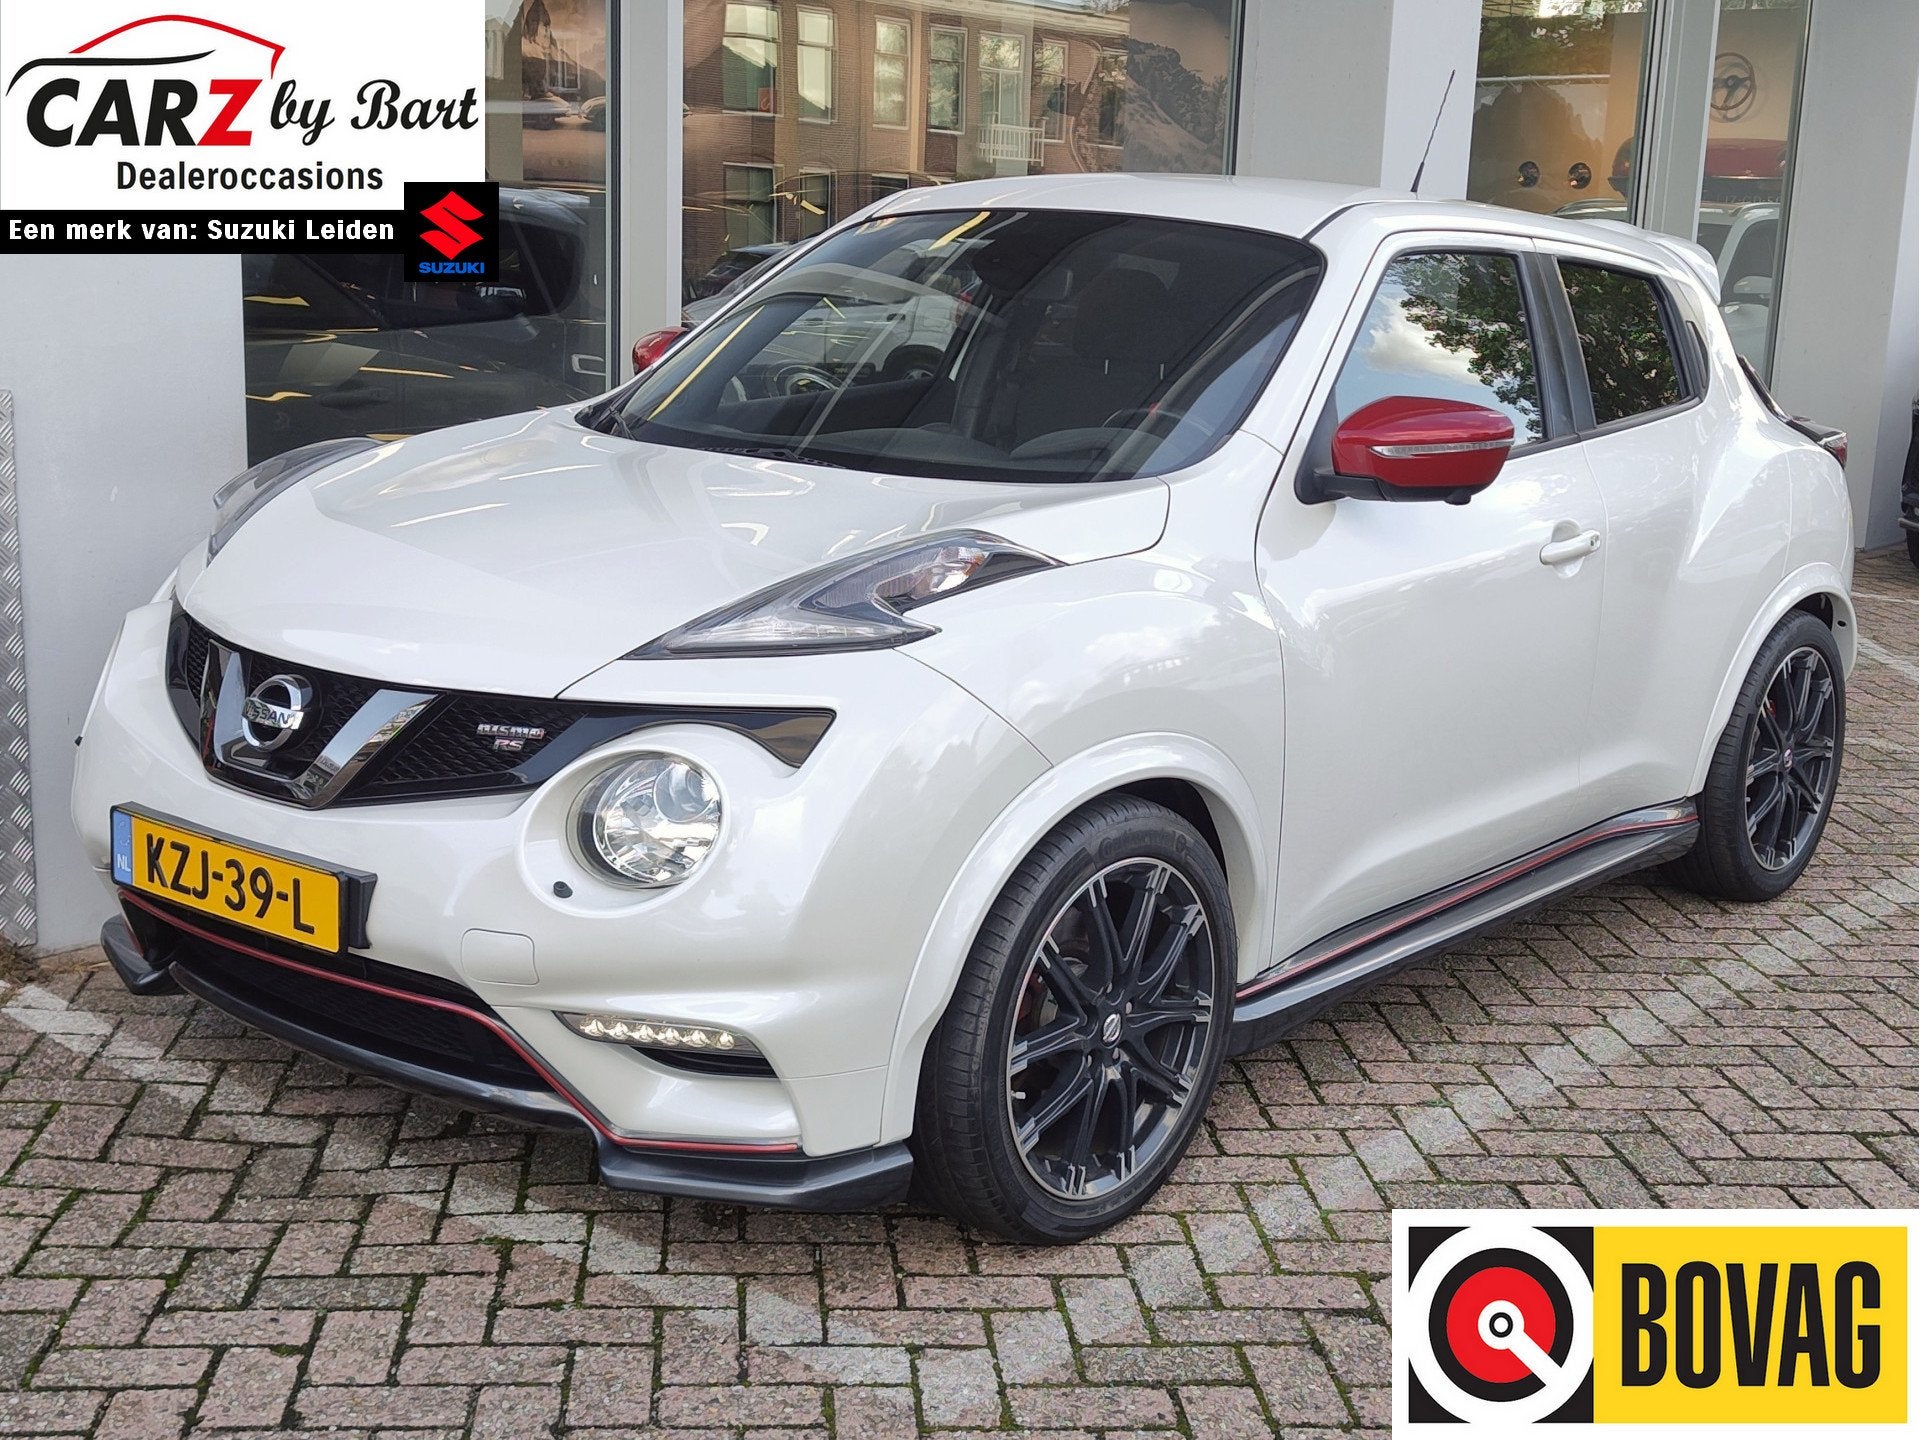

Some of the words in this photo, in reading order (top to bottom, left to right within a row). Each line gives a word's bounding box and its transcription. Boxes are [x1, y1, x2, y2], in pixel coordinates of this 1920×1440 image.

[245, 699, 296, 726] NISSAN
[117, 853, 132, 872] NL
[146, 832, 315, 935] KZJ-39-L
